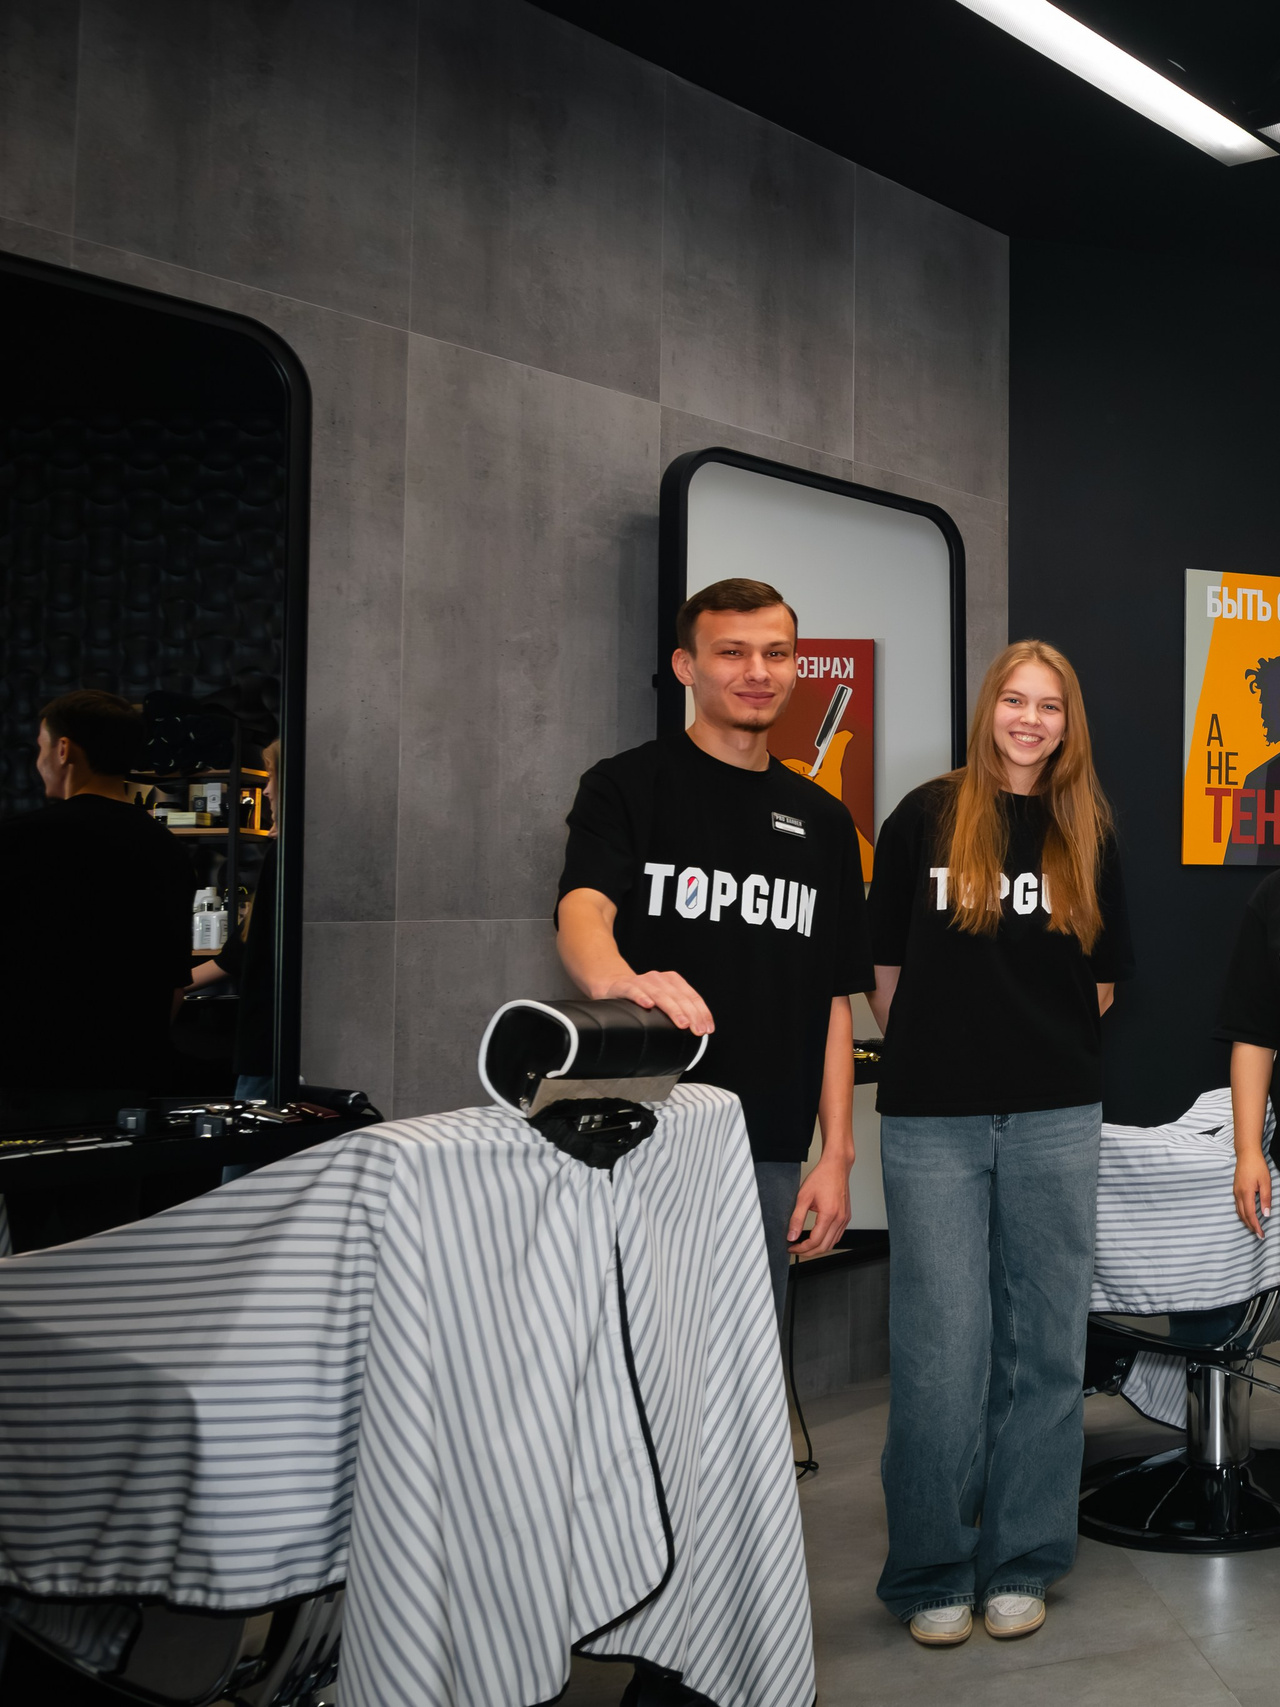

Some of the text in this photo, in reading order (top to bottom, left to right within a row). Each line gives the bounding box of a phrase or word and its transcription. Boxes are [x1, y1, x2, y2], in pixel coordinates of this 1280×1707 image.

[1206, 586, 1272, 622] БЫТЬ
[1206, 713, 1224, 747] А
[1206, 751, 1239, 786] НЕ
[644, 862, 817, 937] TOPGUN
